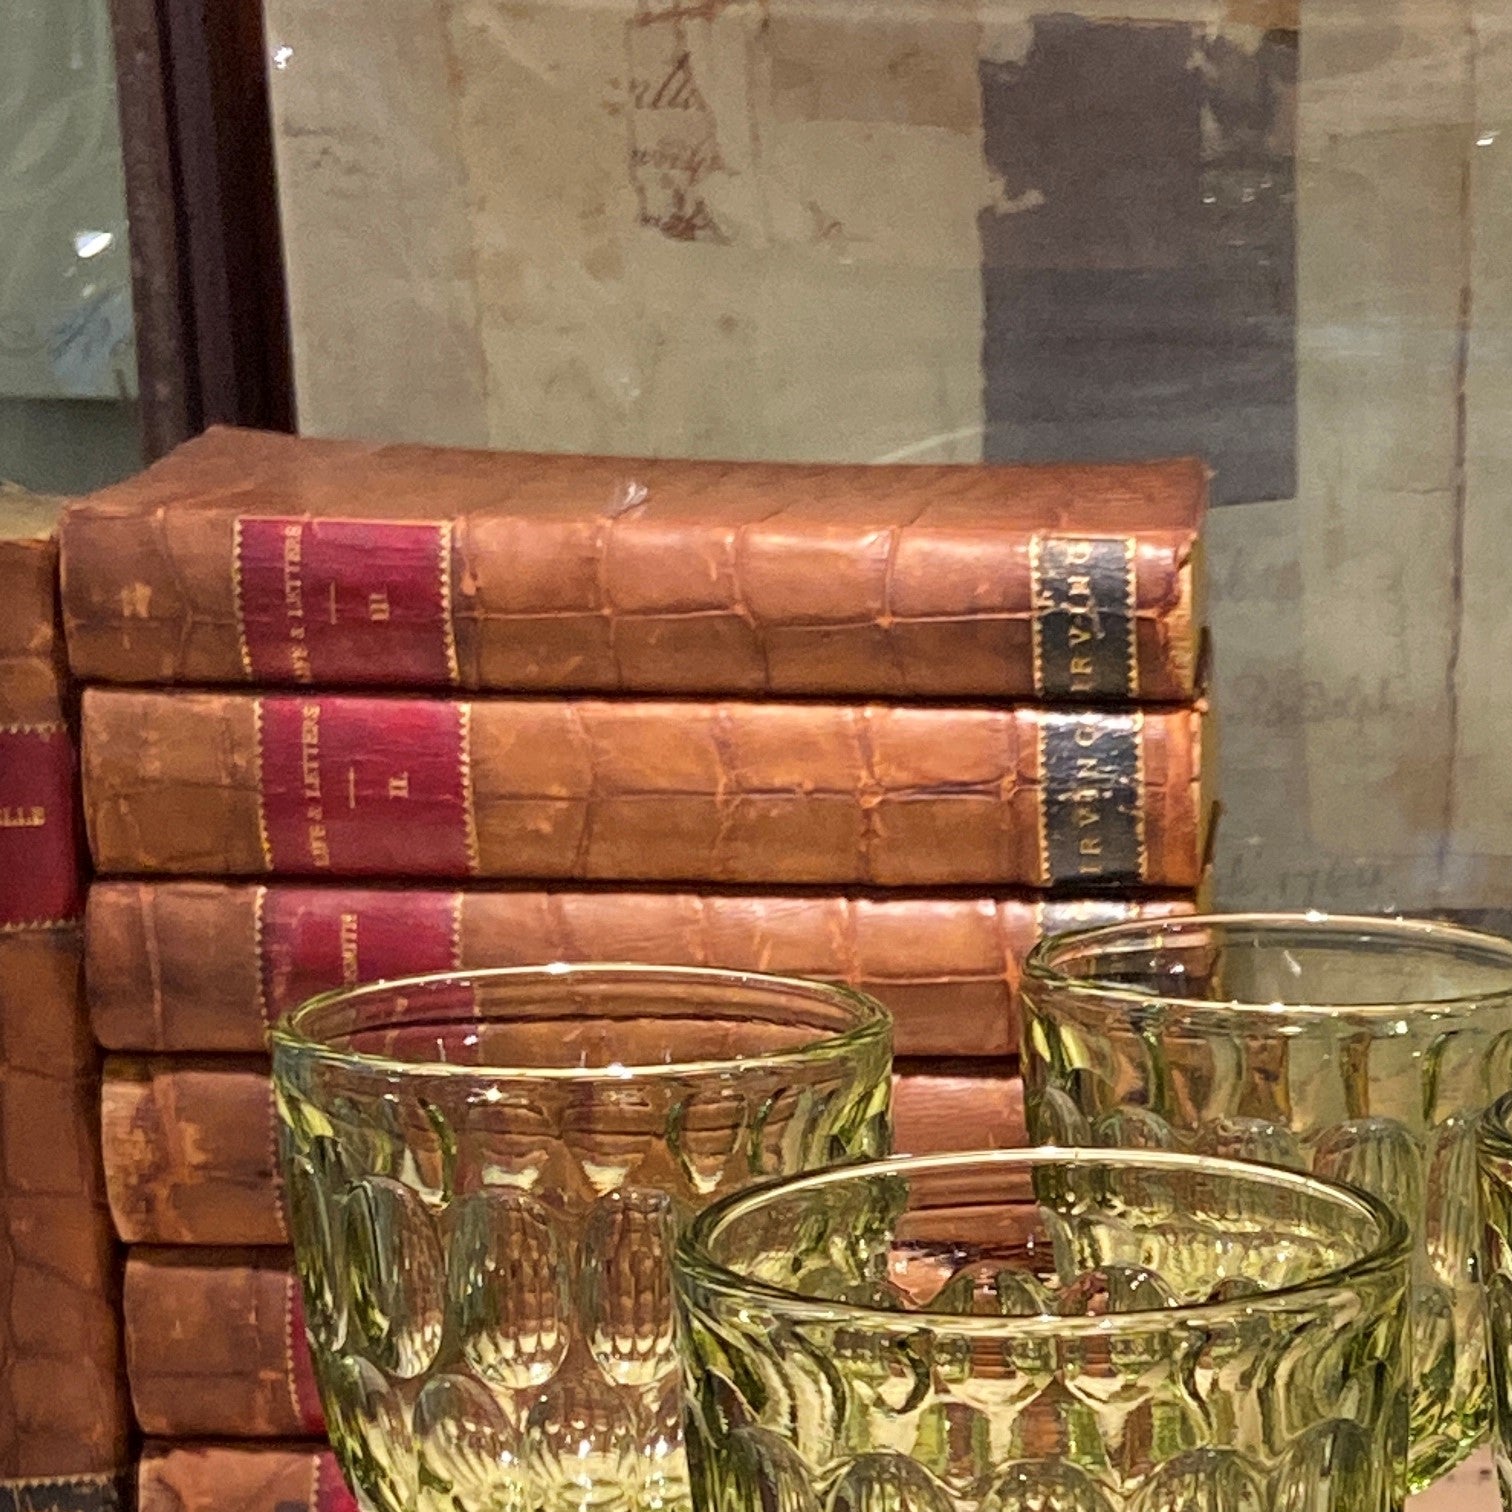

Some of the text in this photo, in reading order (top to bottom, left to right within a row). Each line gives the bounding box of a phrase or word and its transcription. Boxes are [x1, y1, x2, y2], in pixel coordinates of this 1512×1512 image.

[1067, 541, 1095, 693] IRVING
[302, 704, 322, 798] LETTERS
[1073, 723, 1104, 875] IRVING
